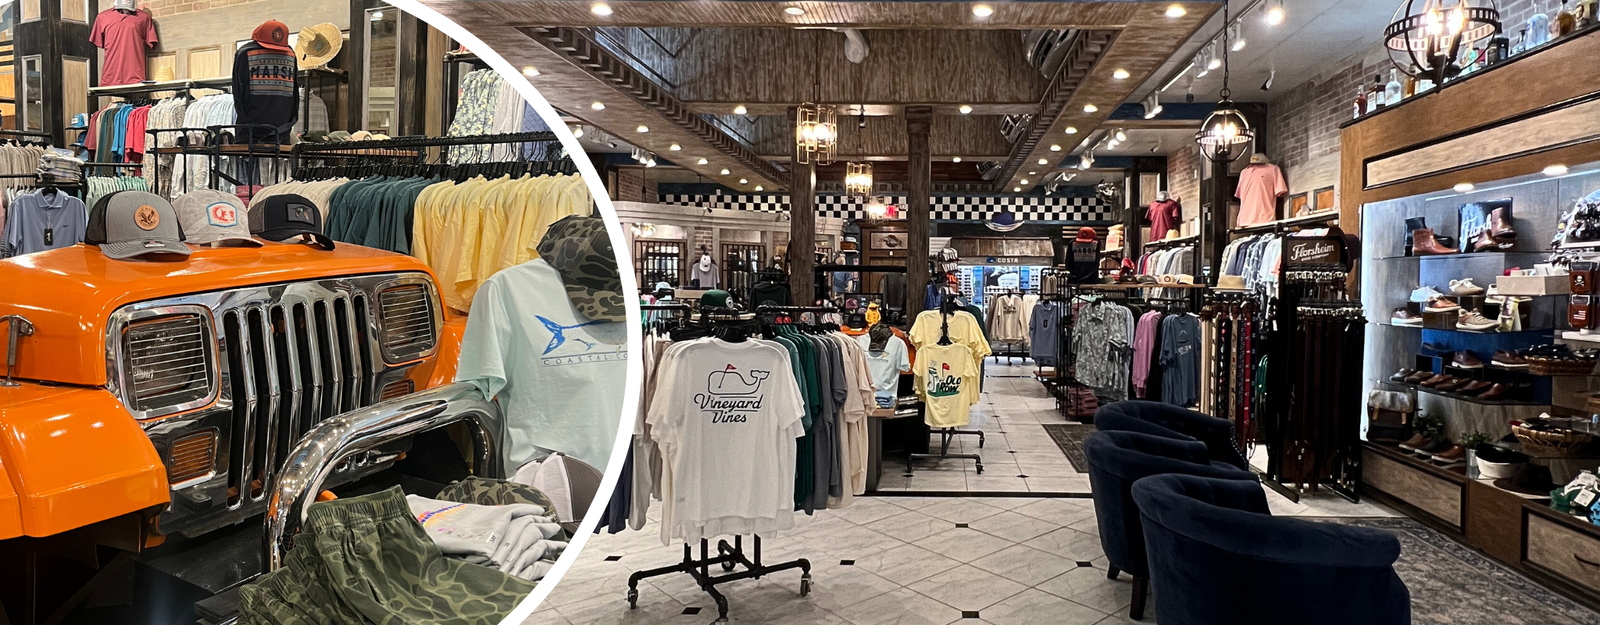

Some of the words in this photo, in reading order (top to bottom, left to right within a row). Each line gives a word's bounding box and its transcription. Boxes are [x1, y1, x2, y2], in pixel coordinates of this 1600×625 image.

[1460, 214, 1492, 243] Florsh
[1290, 242, 1334, 260] Florsheim
[543, 354, 609, 366] COASTAL
[939, 382, 959, 393] ROW
[945, 374, 962, 386] OLD
[693, 393, 764, 412] Vineyard
[711, 409, 747, 424] Vines
